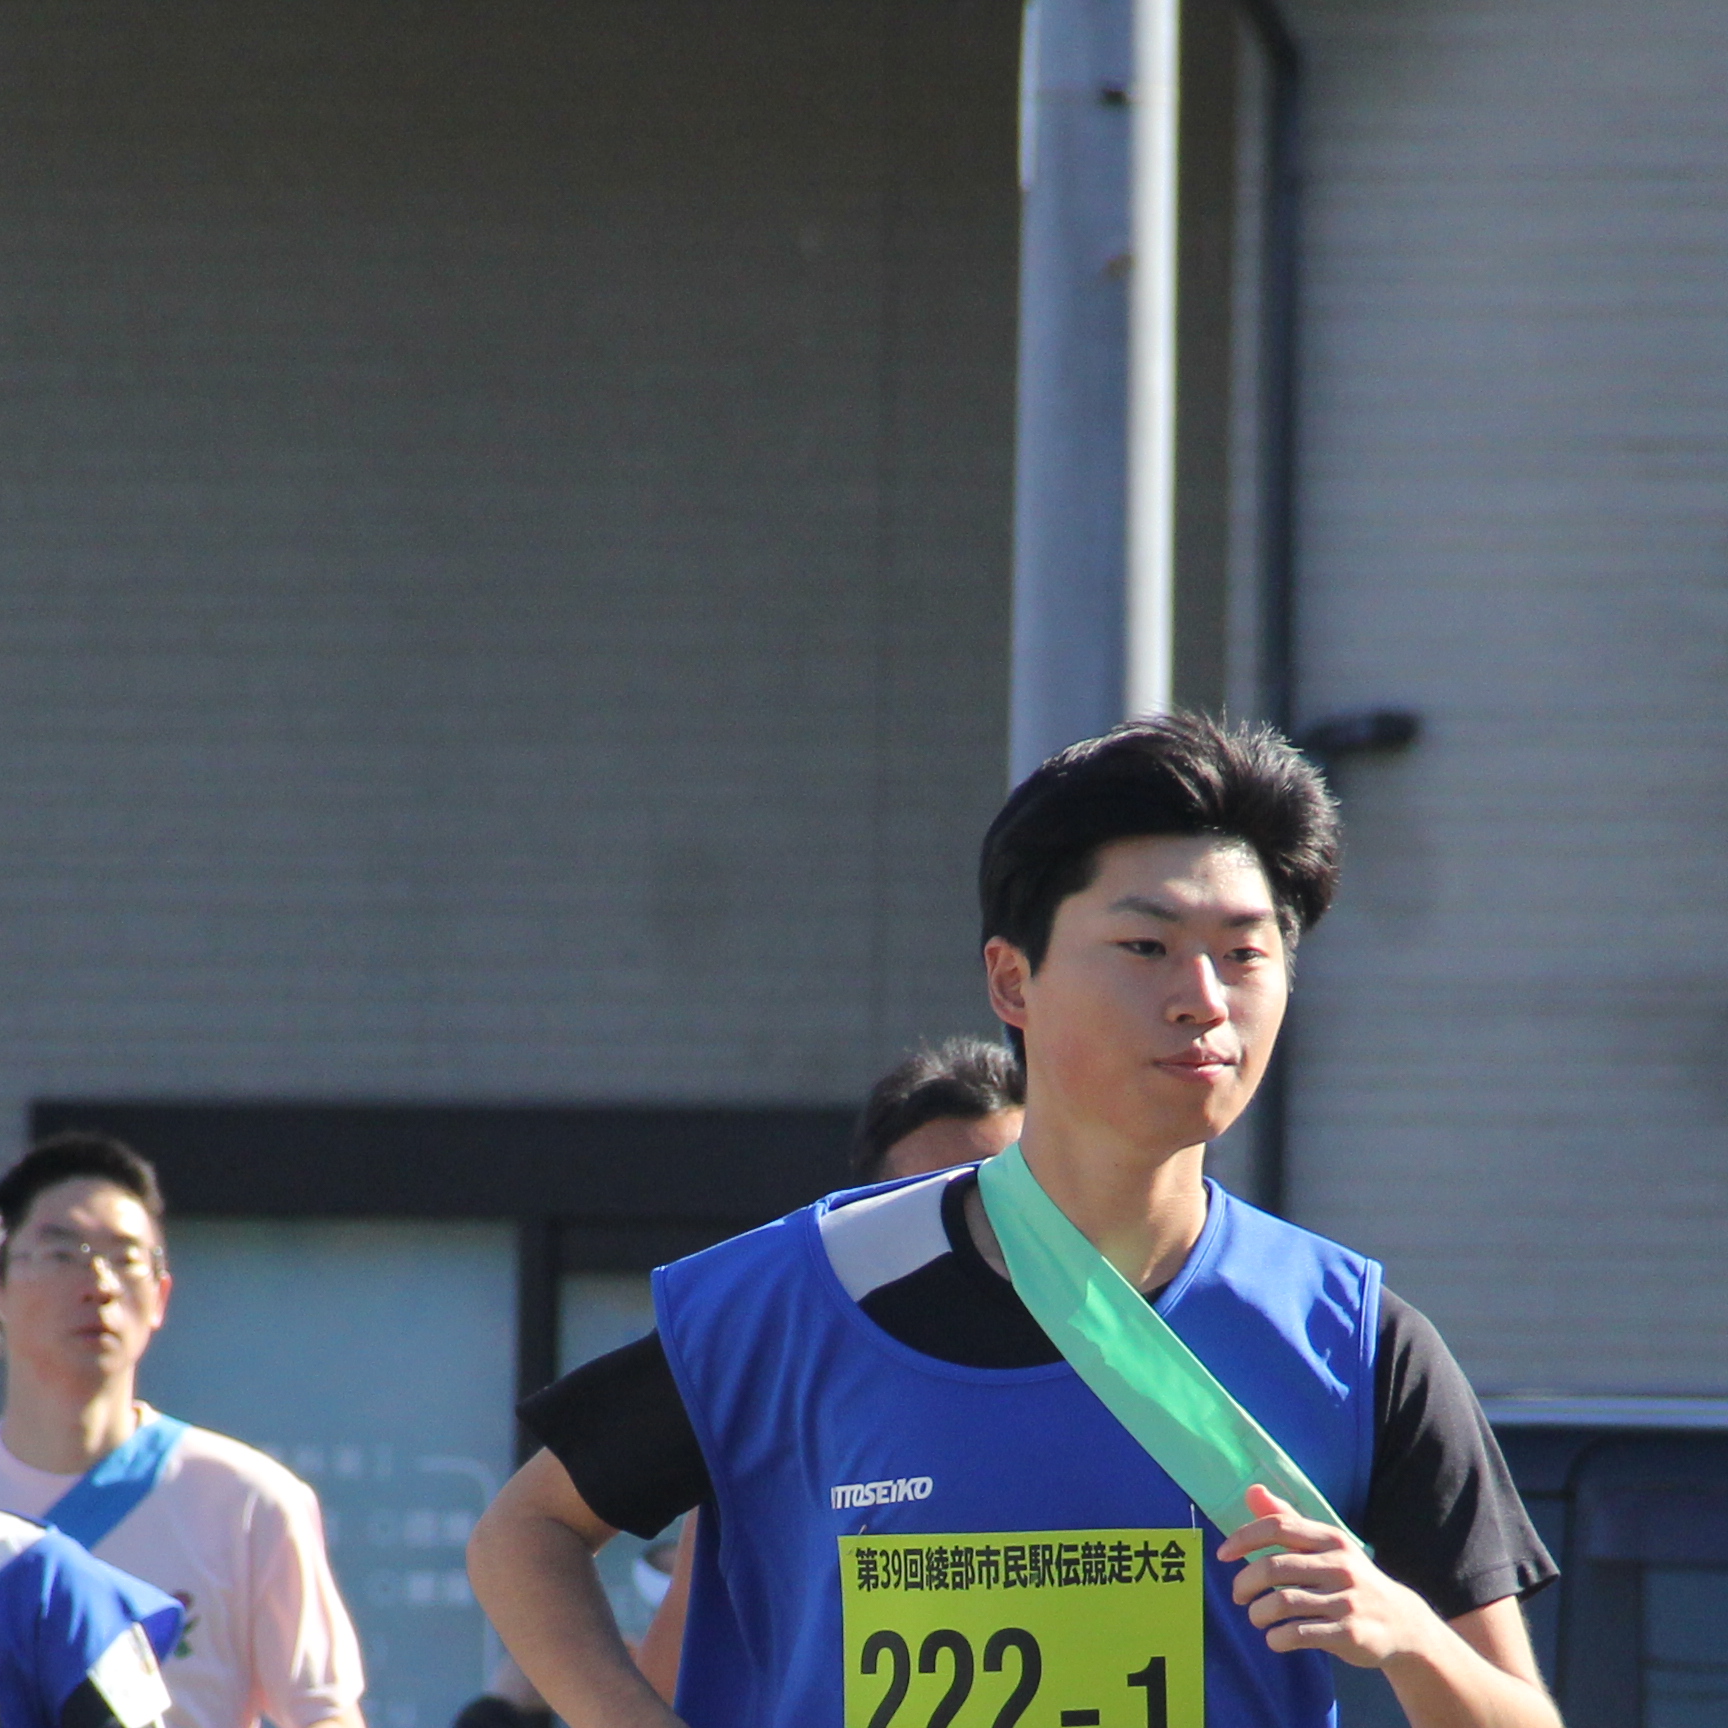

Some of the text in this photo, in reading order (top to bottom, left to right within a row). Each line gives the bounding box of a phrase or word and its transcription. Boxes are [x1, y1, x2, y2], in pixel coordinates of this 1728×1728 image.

[855, 1540, 1186, 1592] 第39回綾部市民駅伝競走大会
